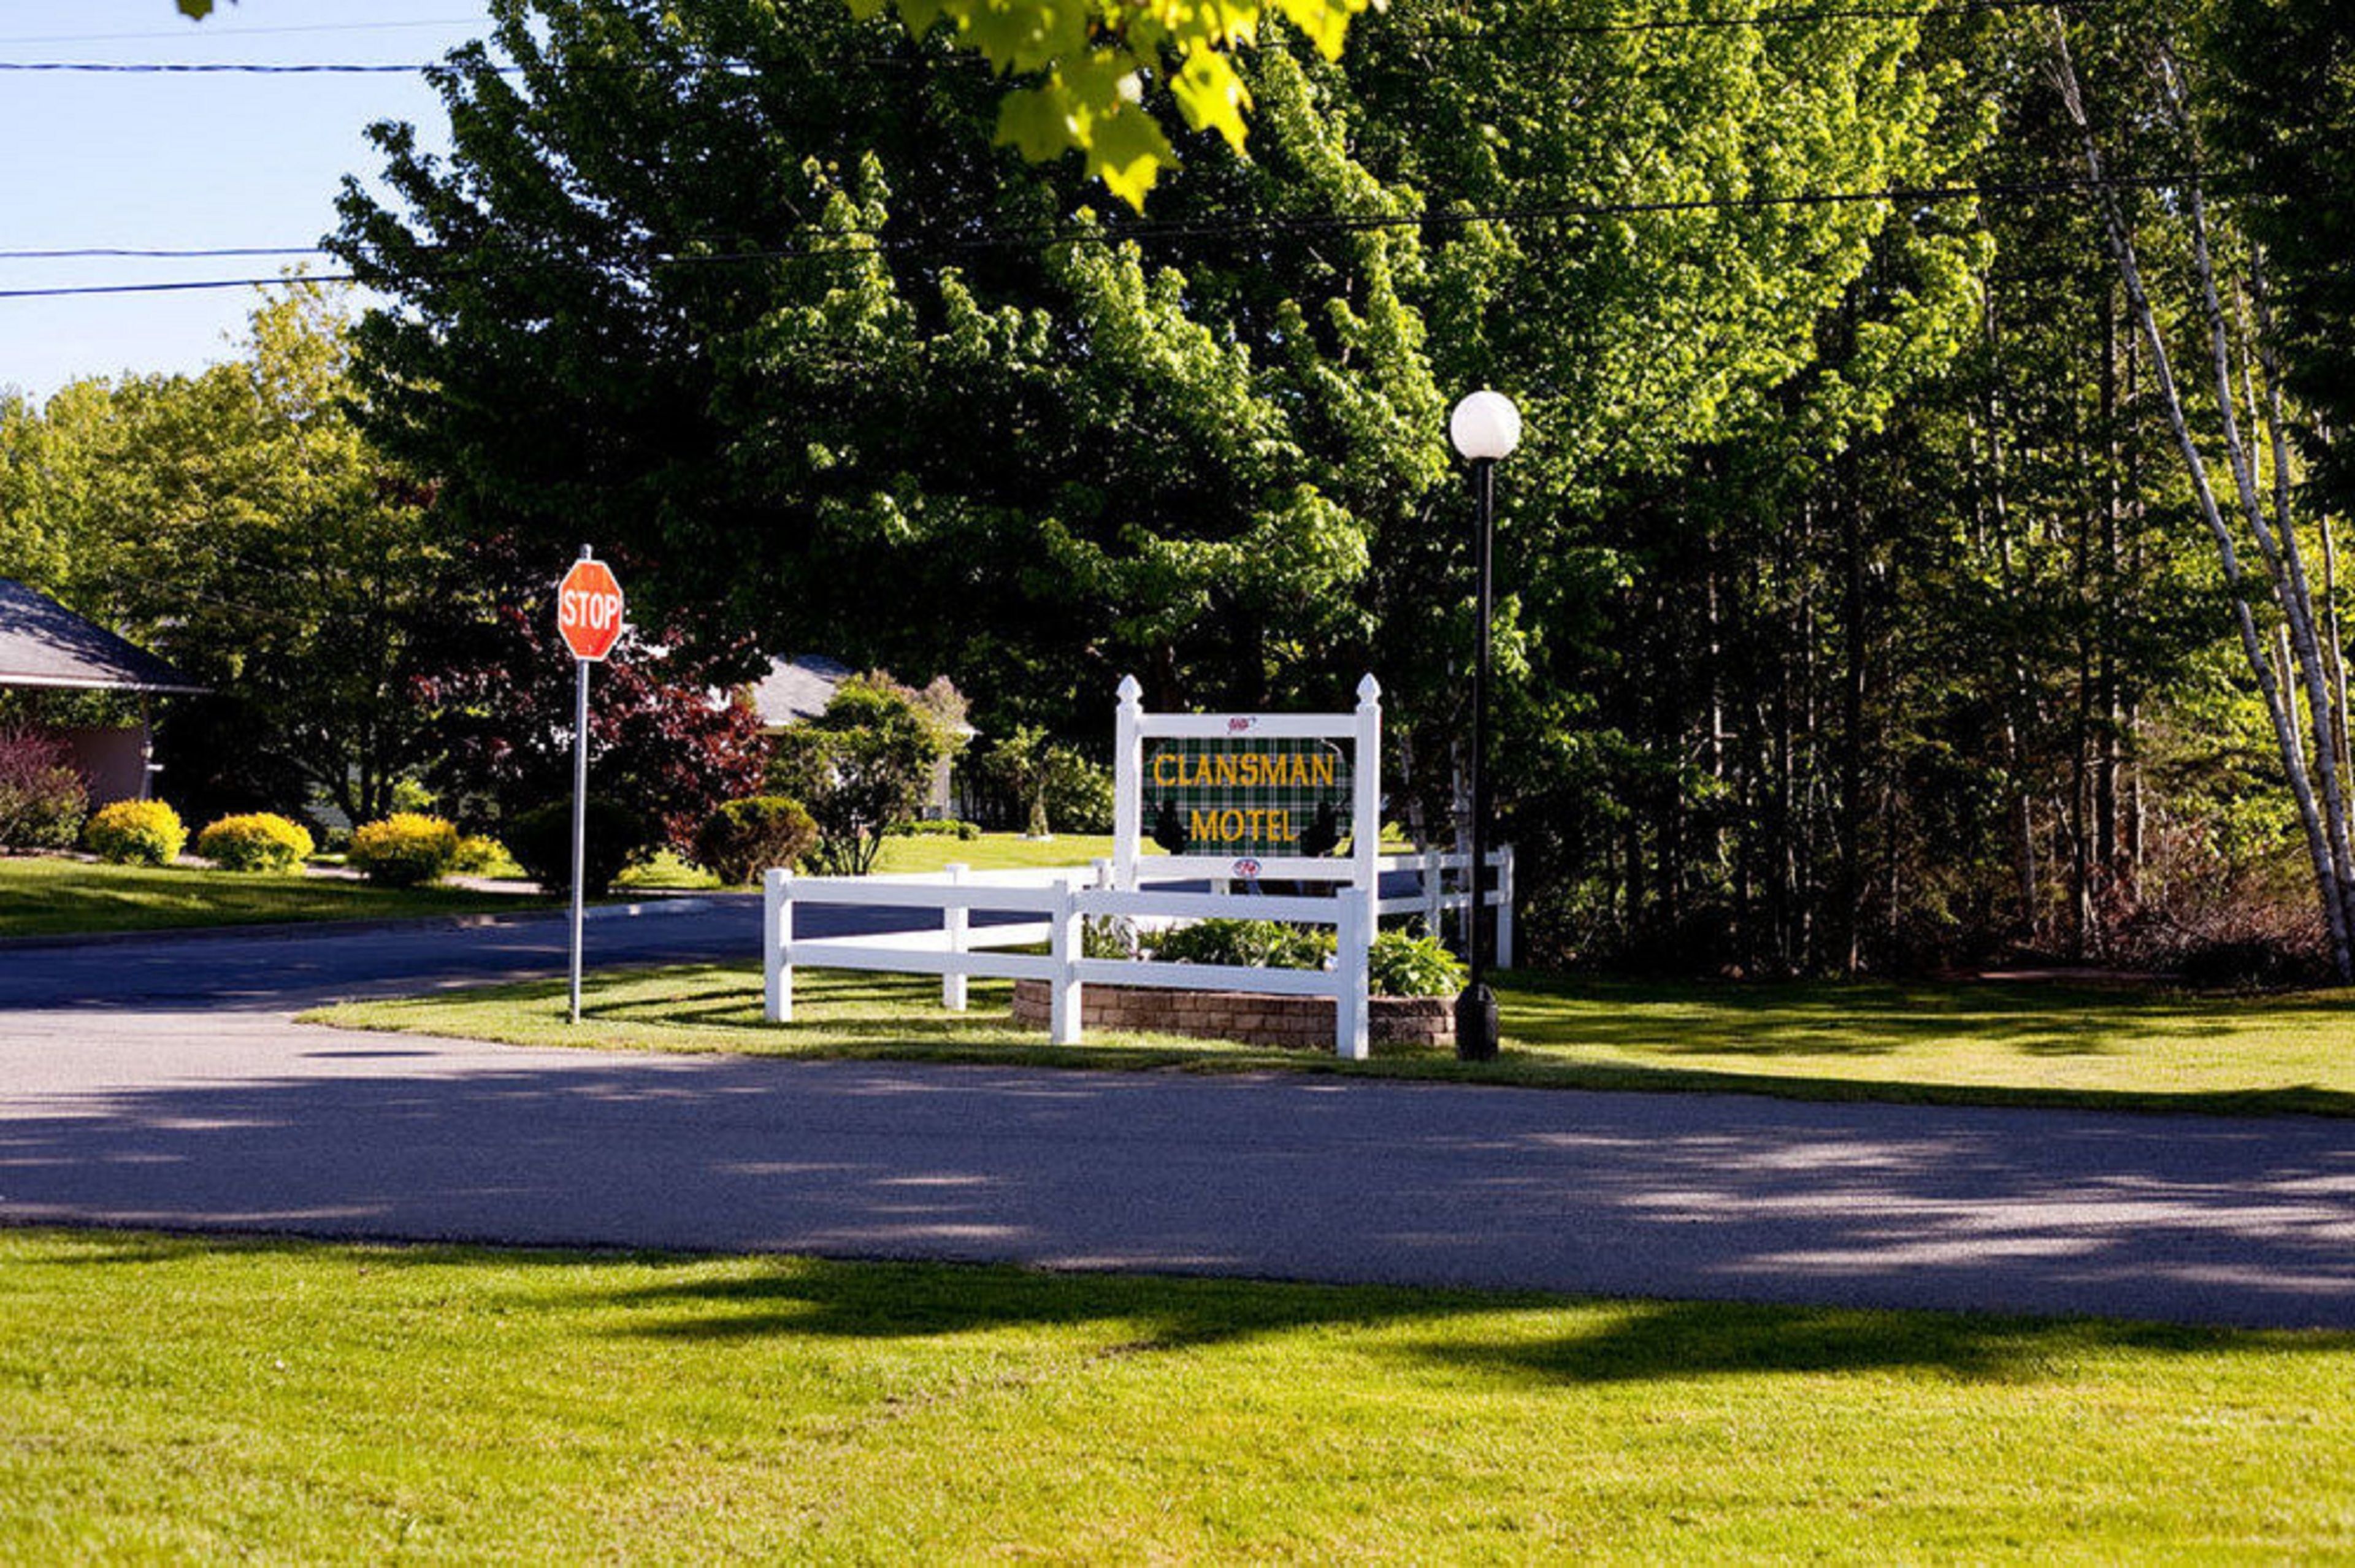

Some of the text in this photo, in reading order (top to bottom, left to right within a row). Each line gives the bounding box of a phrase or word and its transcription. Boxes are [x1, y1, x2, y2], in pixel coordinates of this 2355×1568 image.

[561, 591, 619, 630] STOP
[1154, 753, 1334, 786] CLANSMAN
[1190, 809, 1299, 842] MOTEL
